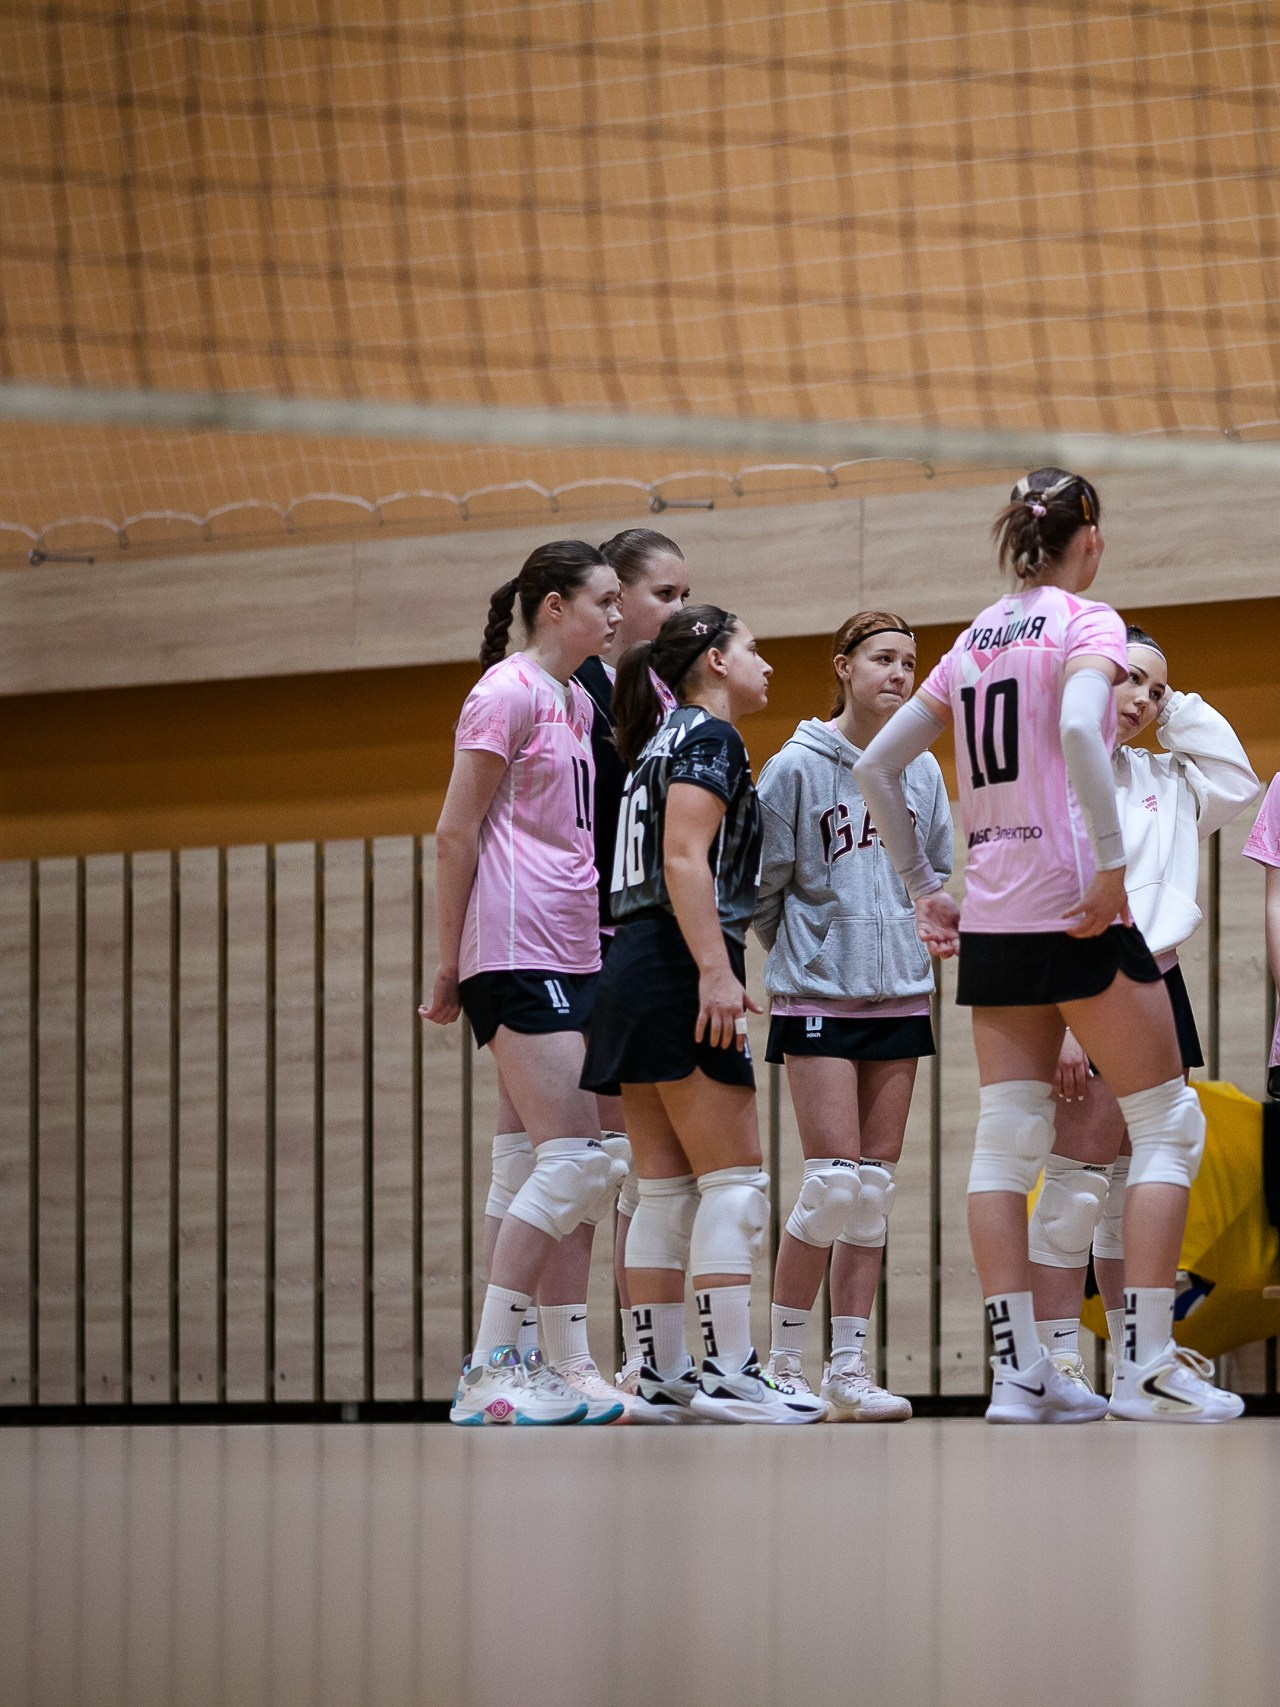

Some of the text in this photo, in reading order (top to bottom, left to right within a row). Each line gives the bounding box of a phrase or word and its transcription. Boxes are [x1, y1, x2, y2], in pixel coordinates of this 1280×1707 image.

[961, 677, 1019, 790] 10
[571, 756, 592, 832] 11
[611, 785, 649, 893] 16
[544, 979, 570, 1008] 11
